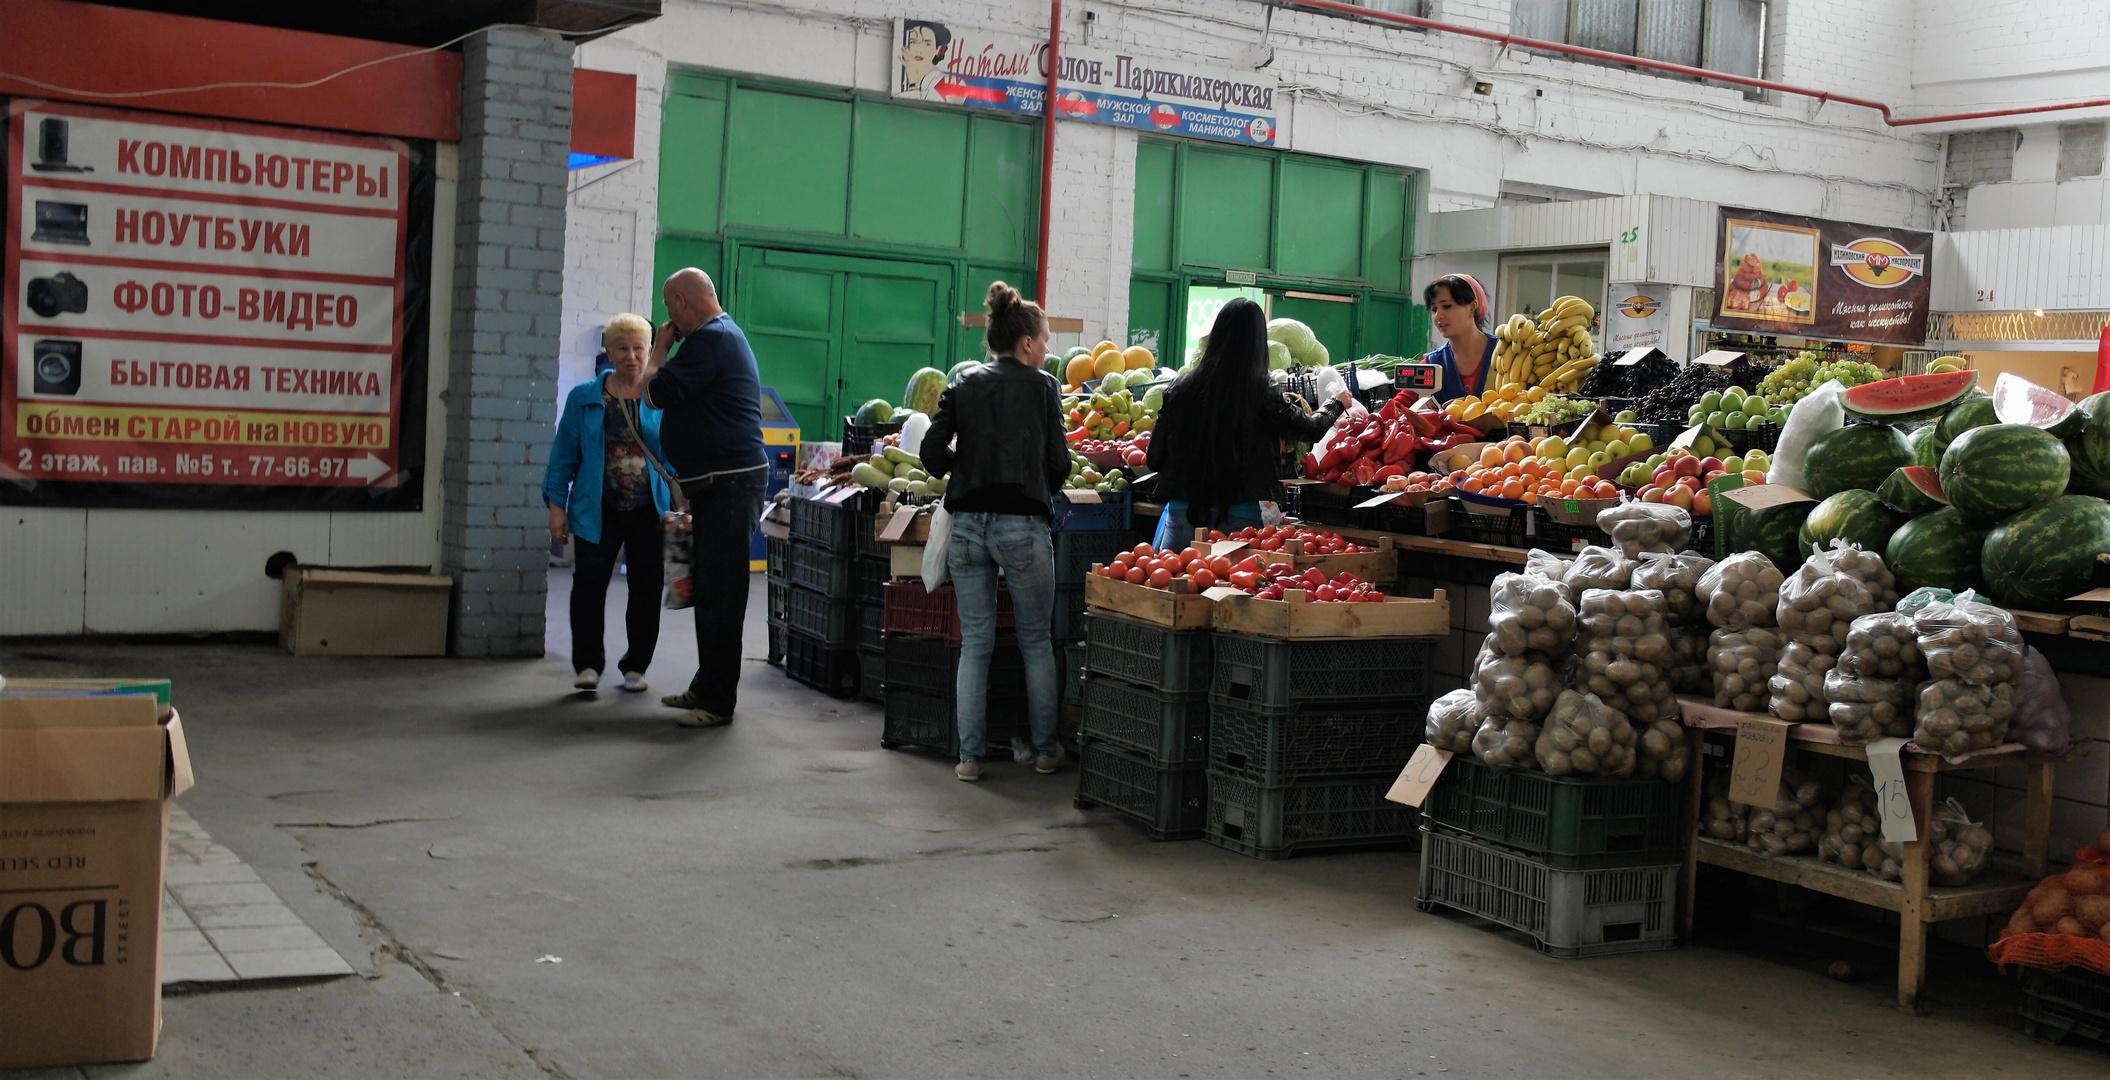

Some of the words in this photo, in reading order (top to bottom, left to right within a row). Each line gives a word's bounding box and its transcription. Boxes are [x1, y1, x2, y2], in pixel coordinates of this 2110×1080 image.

[1020, 100, 1042, 111] ЗАЛ
[1097, 99, 1151, 115] МУЖСКОЙ
[1113, 113, 1135, 124] ЗАЛ
[1181, 110, 1250, 129] КОСМЕТОЛОГ
[1257, 120, 1263, 128] 2
[1189, 123, 1241, 138] МАНИКЮР
[118, 138, 388, 198] КОМПЬЮТЕРЫ
[115, 208, 310, 257] НОУТБУКИ
[1621, 226, 1639, 243] 25
[1229, 272, 1253, 282] ВЫХОД
[113, 280, 358, 330] ФОТО-ВИДЕО
[1976, 289, 1994, 303] 24
[1831, 301, 1865, 315] Мясные
[1849, 319, 1865, 329] как
[110, 359, 250, 390] БЫТОВАЯ
[261, 367, 381, 396] ТЕХНИКА
[26, 409, 120, 437] обмен
[127, 413, 240, 442] СТАРОЙ
[18, 448, 33, 471] 2
[41, 453, 108, 476] этаж,
[118, 455, 166, 474] пав.
[175, 453, 214, 475] №5
[221, 459, 239, 476] т.
[248, 455, 345, 478] 77-66-97
[1398, 749, 1445, 784] 20
[1734, 746, 1769, 782] 22
[1878, 780, 1908, 820] 15
[117, 899, 129, 965] STREET
